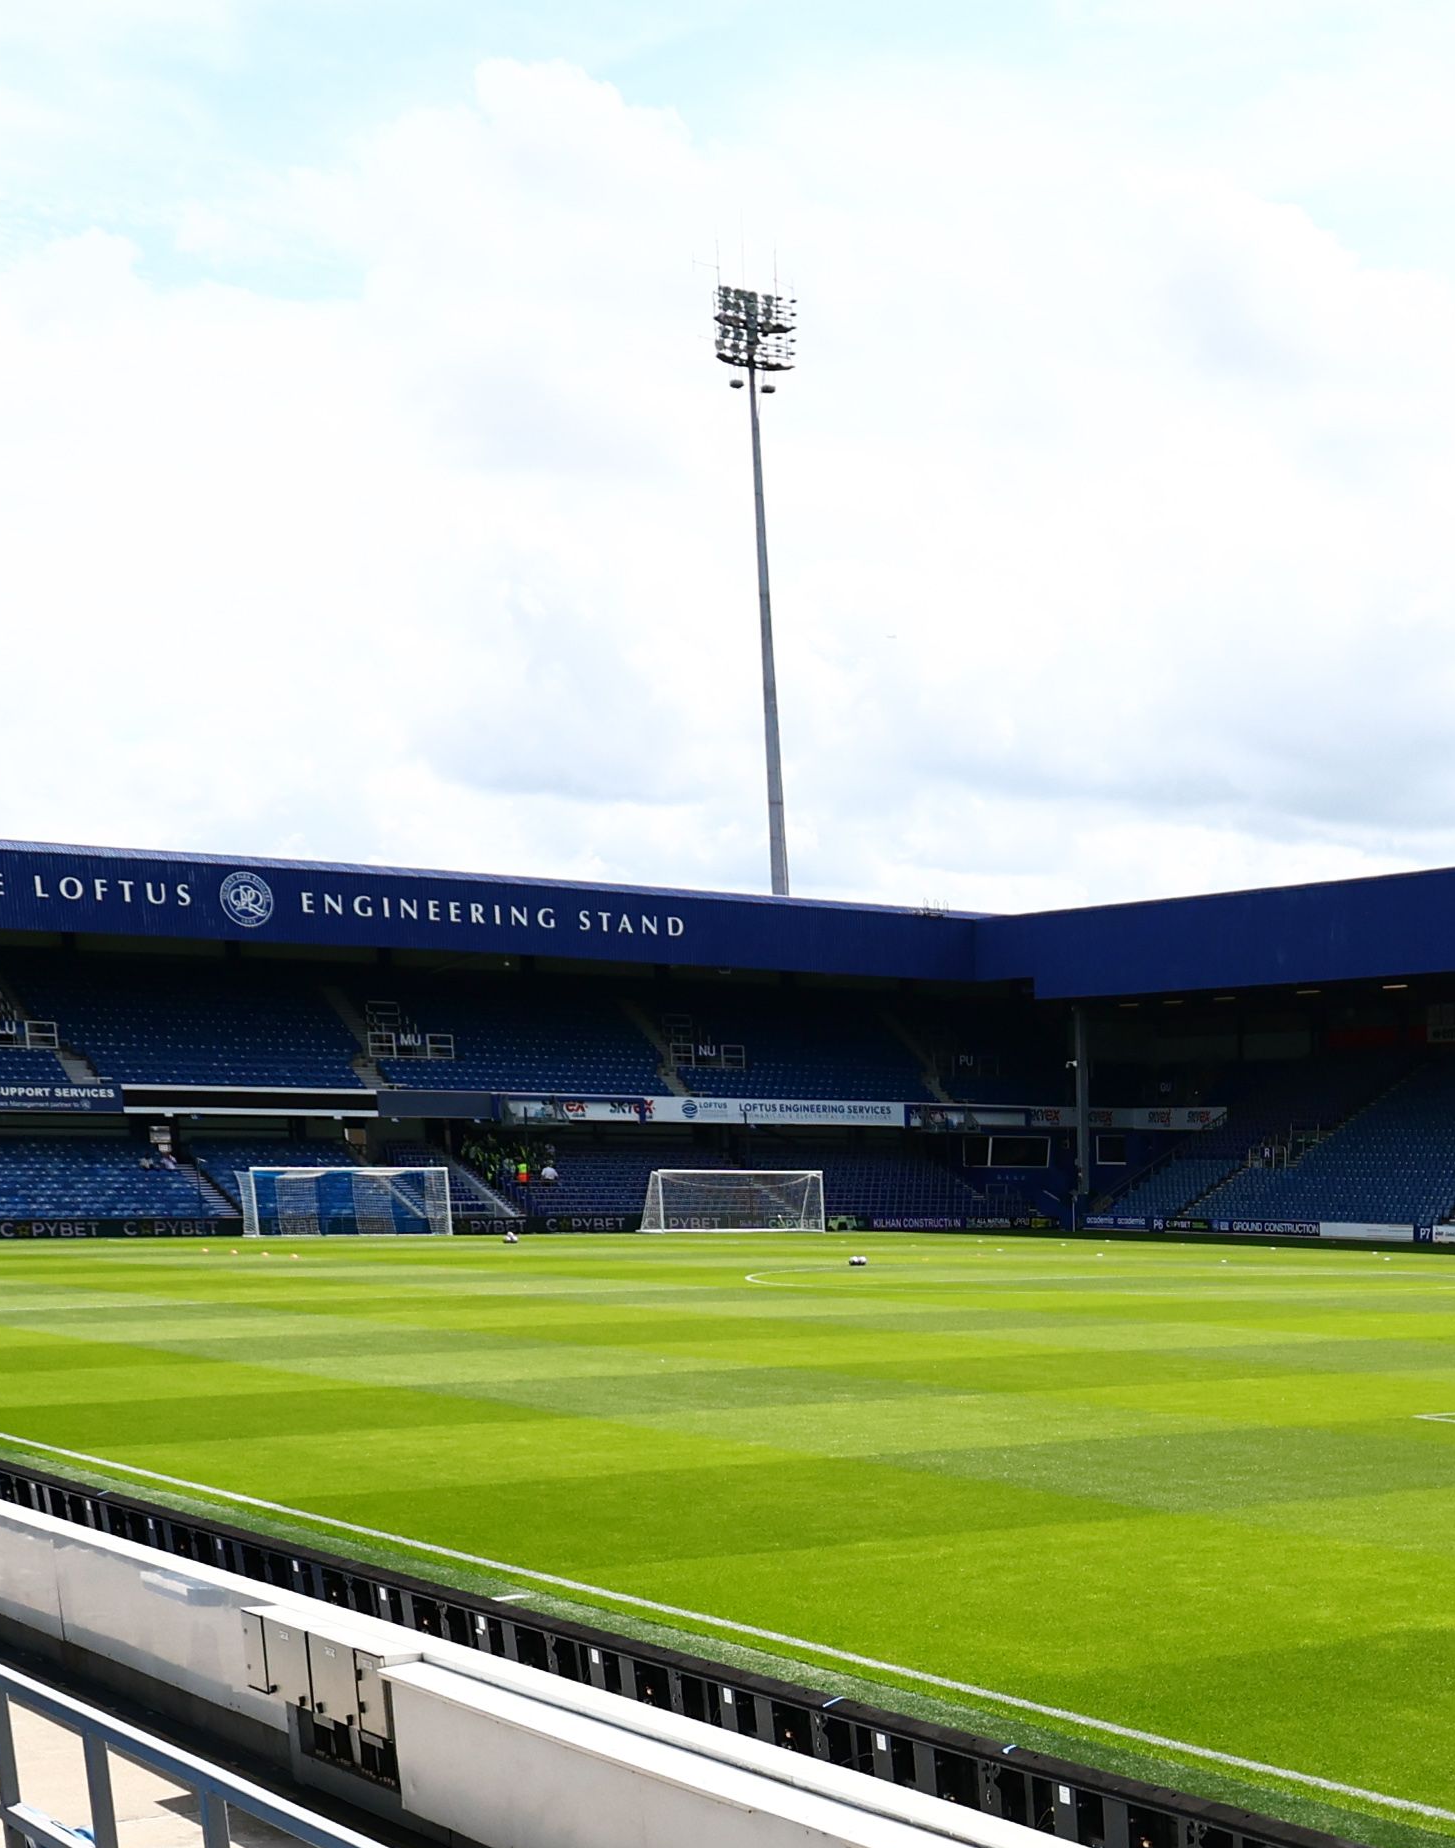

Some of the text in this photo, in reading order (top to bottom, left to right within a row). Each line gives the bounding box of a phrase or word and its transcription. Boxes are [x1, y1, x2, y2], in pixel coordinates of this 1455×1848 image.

[34, 874, 192, 906] LOFTUS
[300, 891, 556, 929] ENGINEERING
[578, 910, 685, 937] STAND
[400, 1033, 421, 1046] MU
[698, 1045, 716, 1057] NU
[54, 1087, 115, 1098] SERVICES
[739, 1103, 891, 1115] LOFTUS ENGINEERING SERVICES
[1153, 1219, 1164, 1230] P6
[1232, 1220, 1263, 1231] GROUND
[1264, 1221, 1320, 1234] CONSTRUCTION
[1420, 1228, 1431, 1240] P7
